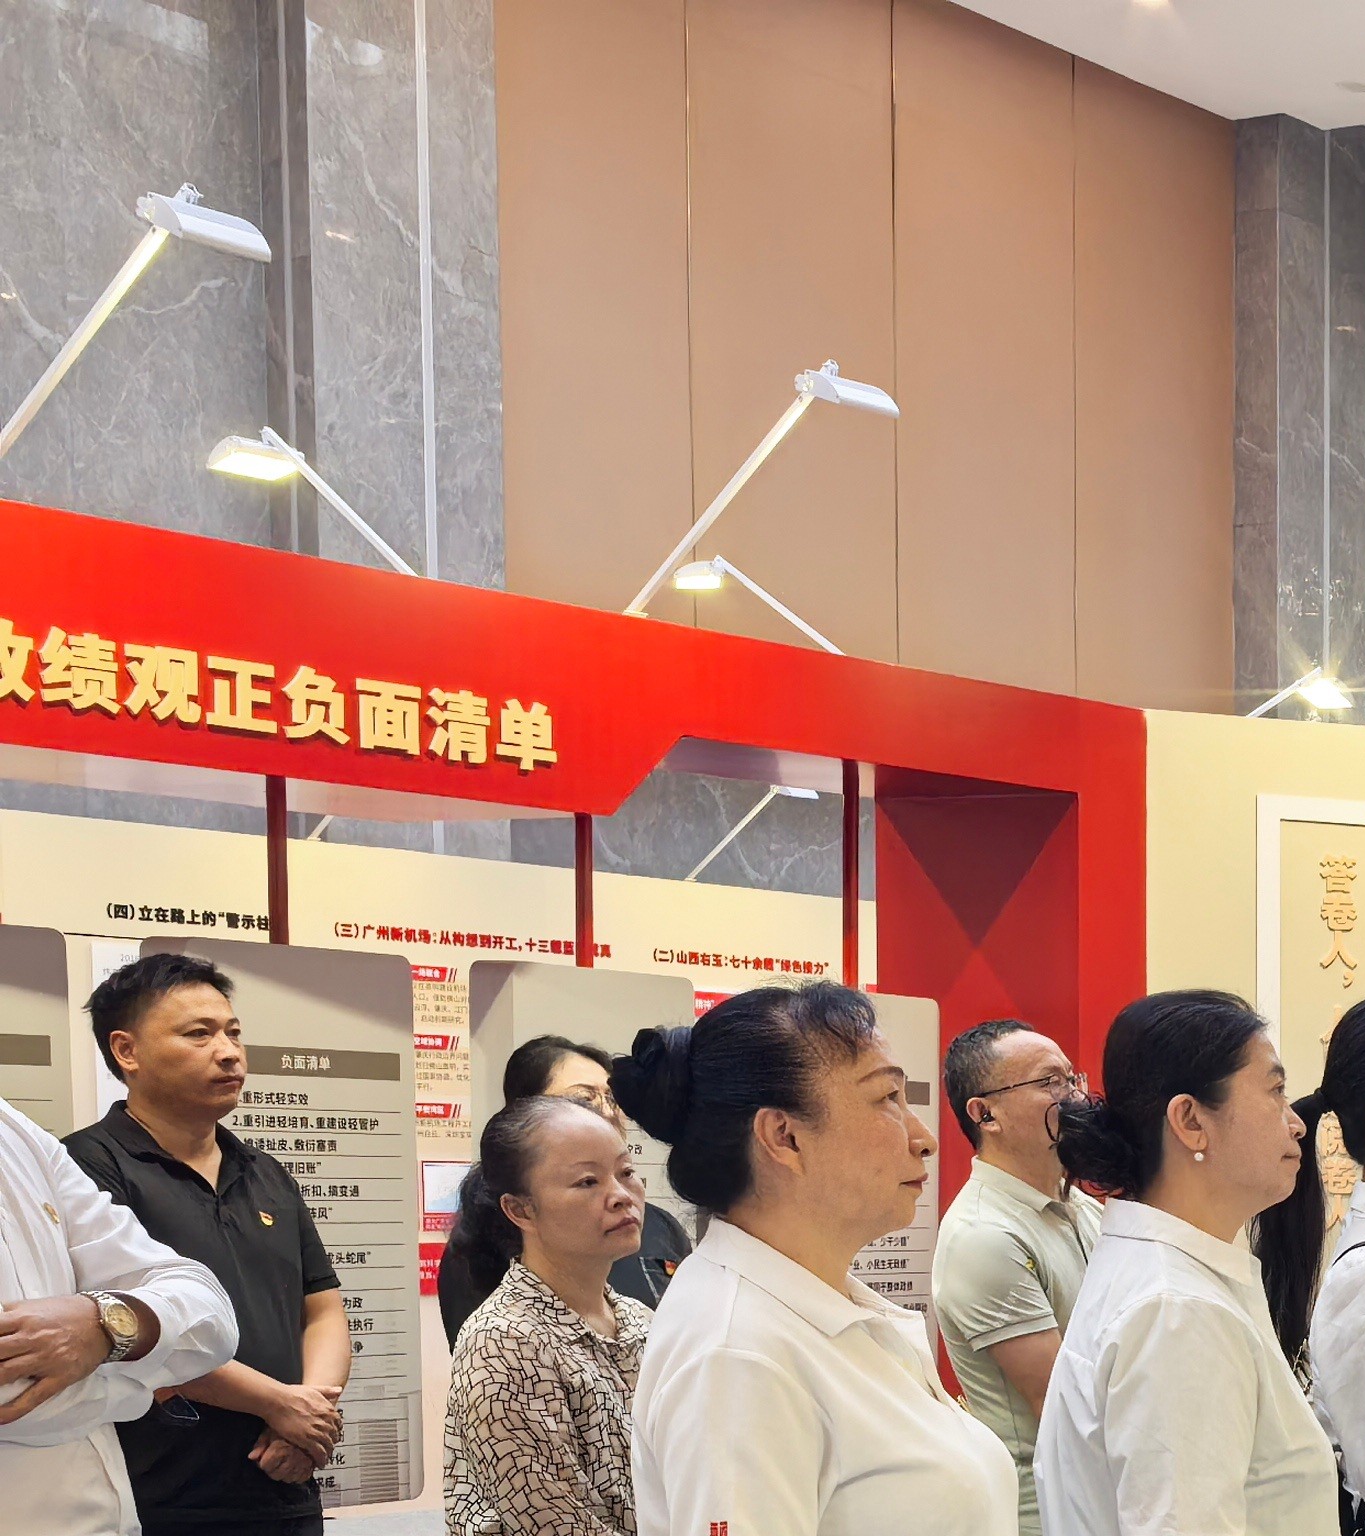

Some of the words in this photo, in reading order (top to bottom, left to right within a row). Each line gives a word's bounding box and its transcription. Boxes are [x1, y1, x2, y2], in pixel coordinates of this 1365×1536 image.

[280, 1054, 332, 1071] 负面清单
[280, 1161, 322, 1174] 理旧账”
